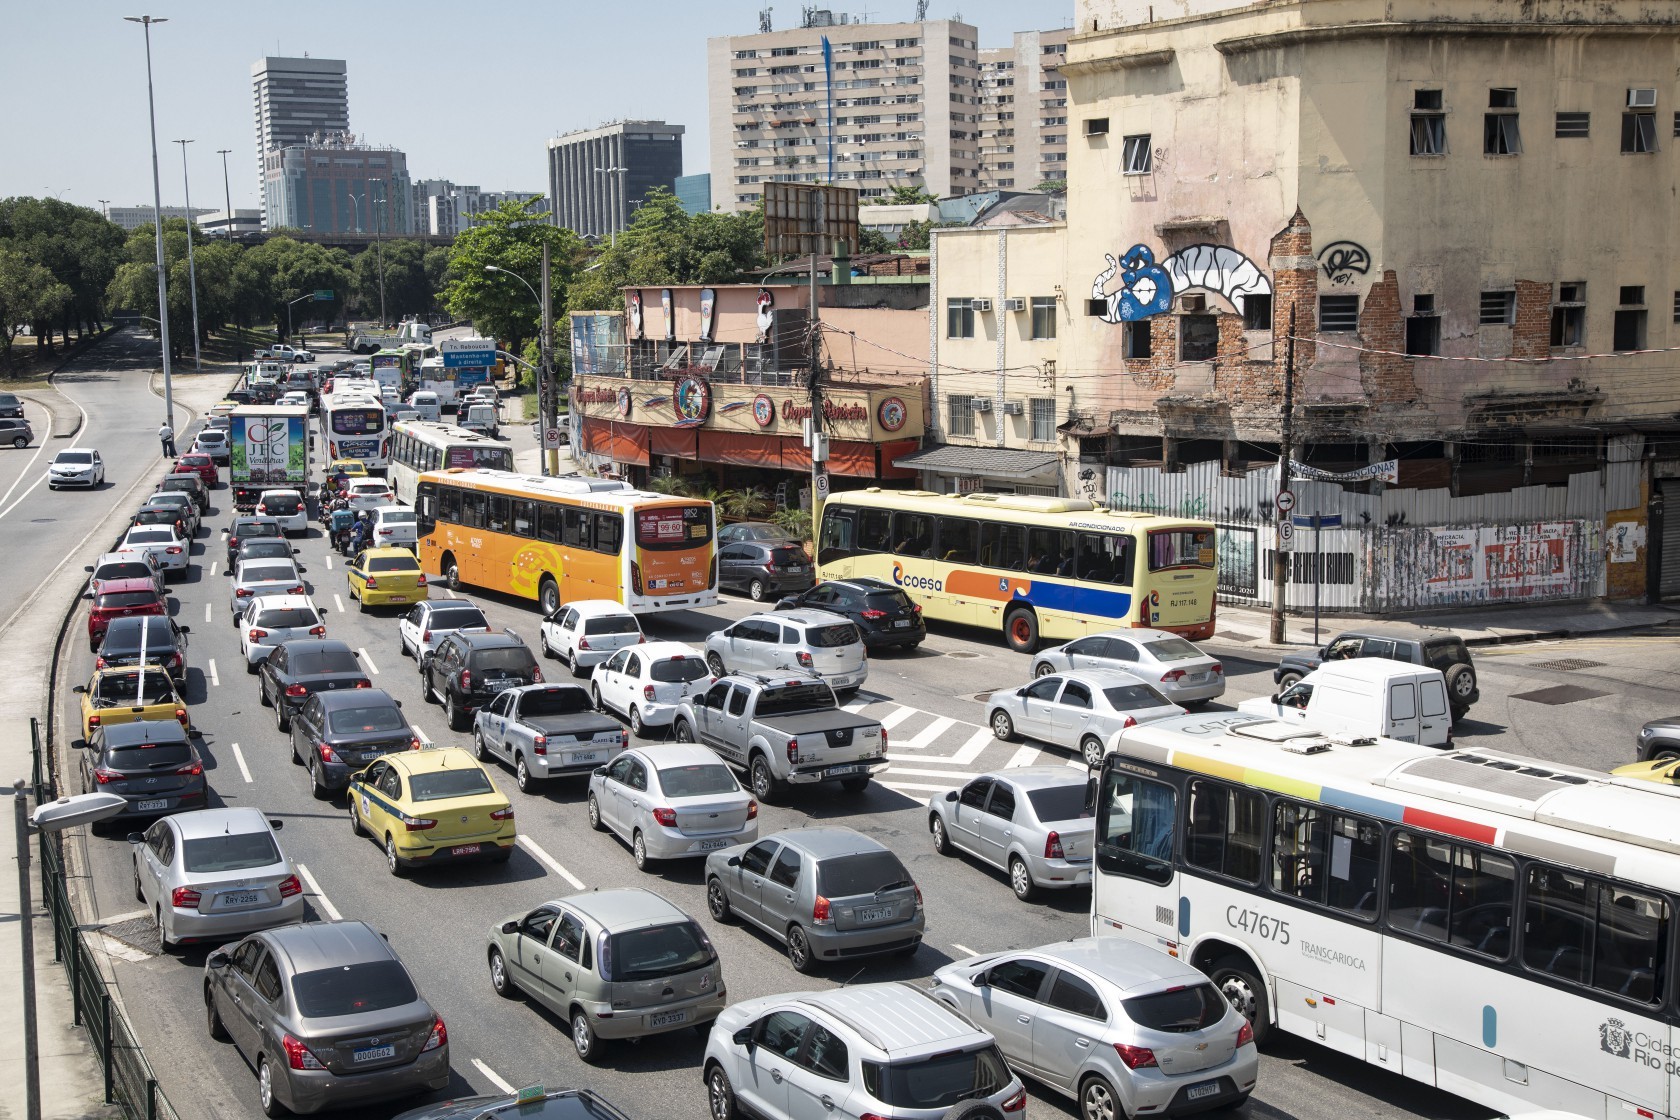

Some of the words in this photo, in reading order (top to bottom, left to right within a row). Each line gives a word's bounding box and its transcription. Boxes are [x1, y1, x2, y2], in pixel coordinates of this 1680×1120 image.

[959, 477, 983, 493] HOTEL
[903, 574, 942, 592] coesa
[421, 743, 437, 751] TAXI
[1227, 905, 1290, 945] C47675
[1300, 940, 1366, 971] TRANSCARIOCA
[1634, 1048, 1661, 1069] Rio
